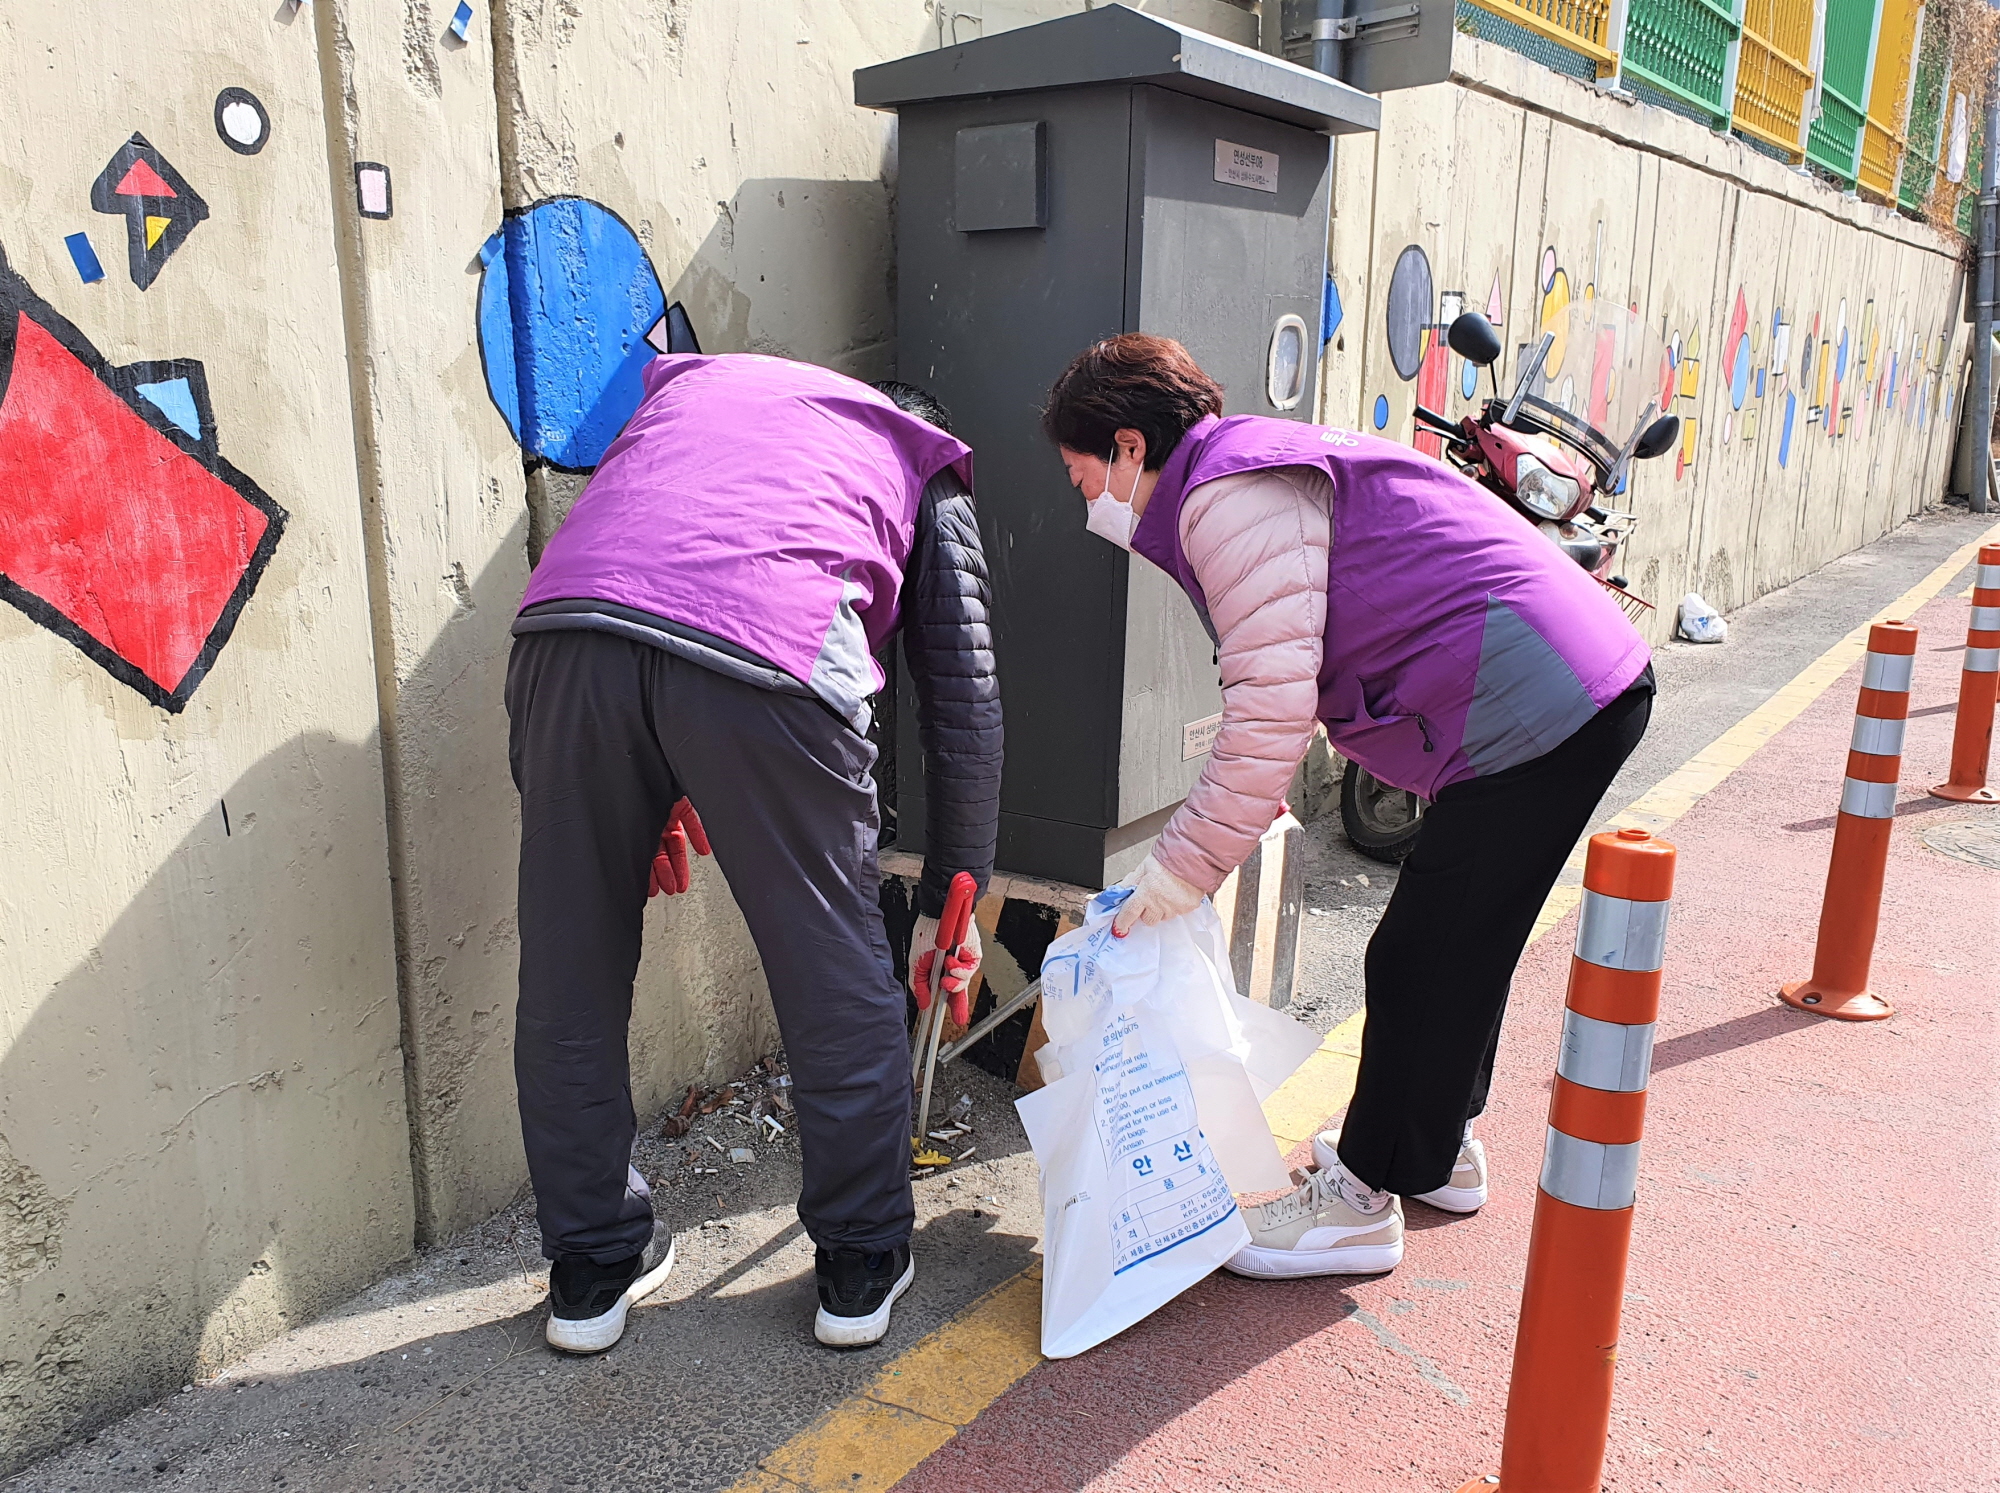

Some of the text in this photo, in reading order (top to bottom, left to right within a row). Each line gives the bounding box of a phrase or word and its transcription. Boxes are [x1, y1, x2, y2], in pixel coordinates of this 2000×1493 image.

[1189, 725, 1206, 740] 안산시
[1127, 1062, 1148, 1075] waste
[1100, 1085, 1115, 1095] This
[1129, 1086, 1141, 1097] put
[1142, 1080, 1154, 1090] out
[1155, 1069, 1184, 1085] between
[1132, 1105, 1148, 1115] won
[1158, 1095, 1172, 1105] less
[1132, 1117, 1142, 1127] for
[1143, 1112, 1156, 1122] the
[1157, 1108, 1169, 1117] use
[1171, 1102, 1178, 1111] of
[1127, 1127, 1148, 1139] bags.
[1123, 1139, 1145, 1152] Ansan
[1180, 1199, 1195, 1211] 크기
[1182, 1207, 1199, 1219] KPS
[1200, 1202, 1208, 1210] M
[1130, 1242, 1152, 1257] 제품은
